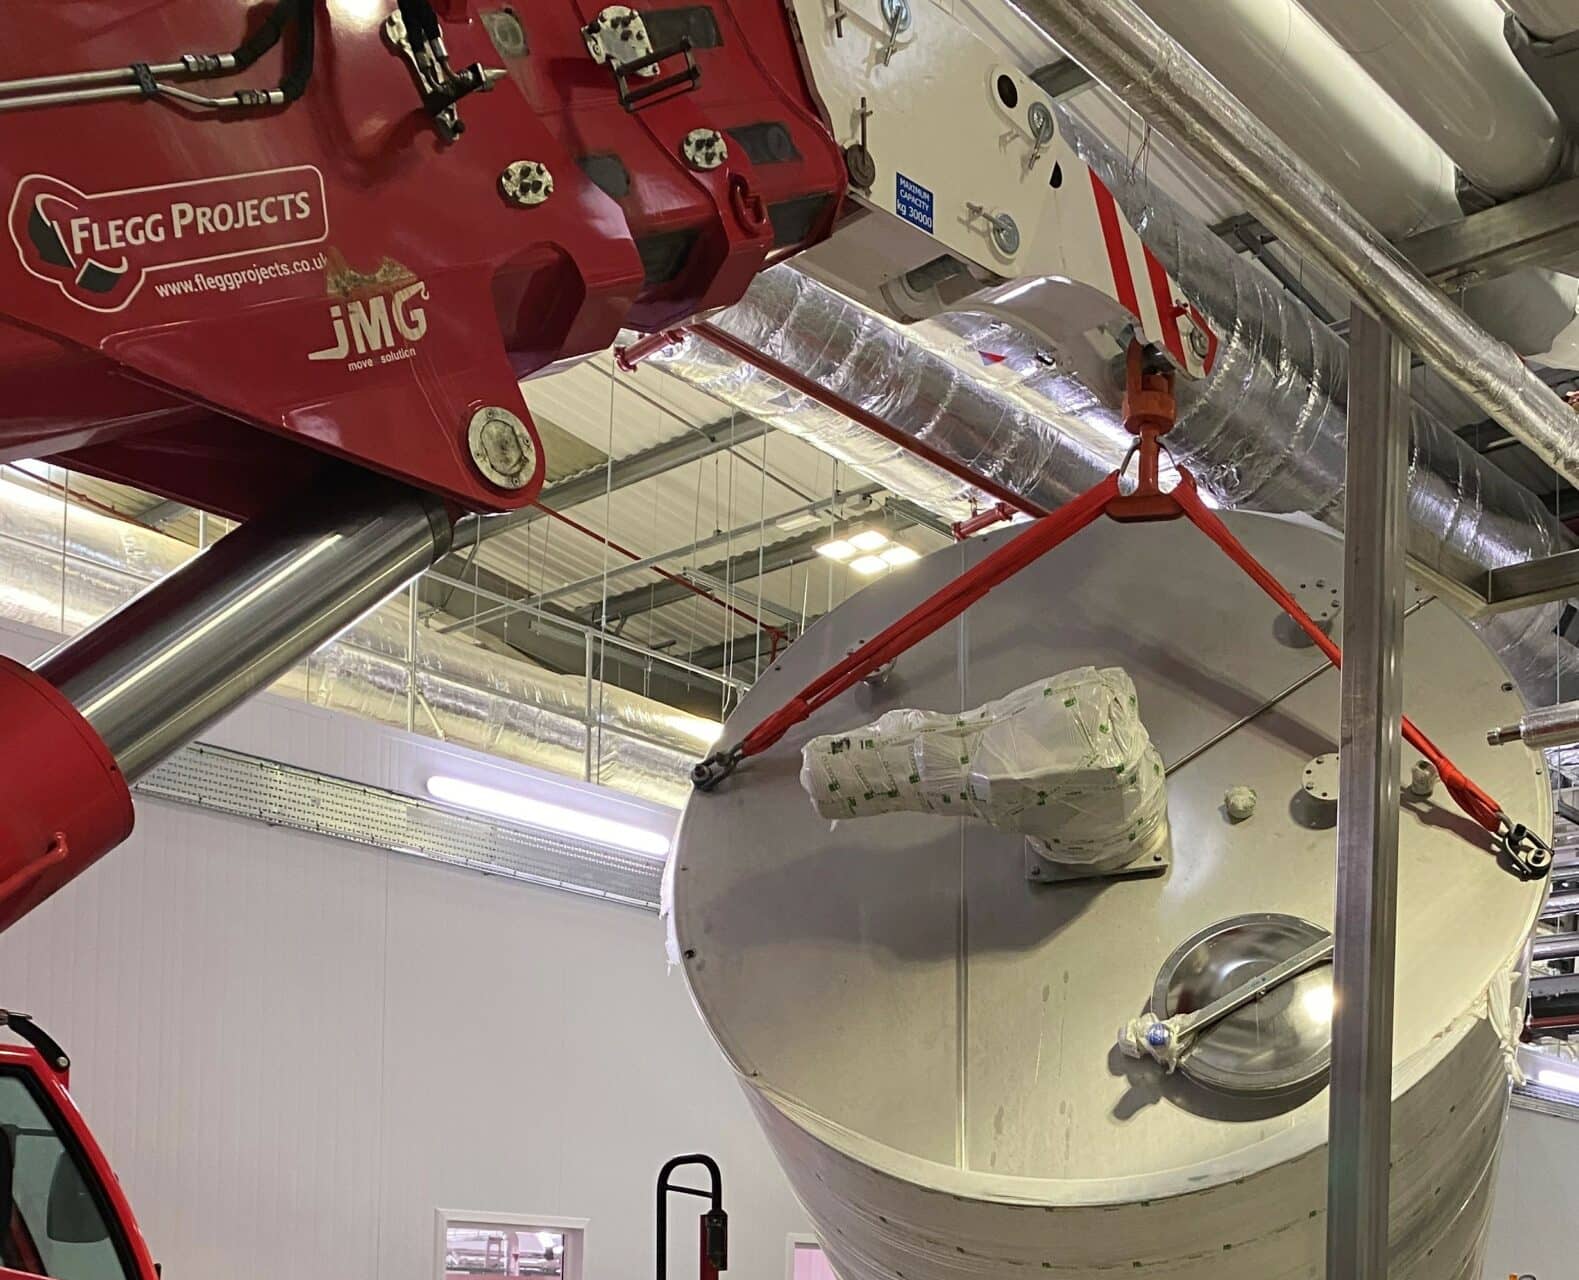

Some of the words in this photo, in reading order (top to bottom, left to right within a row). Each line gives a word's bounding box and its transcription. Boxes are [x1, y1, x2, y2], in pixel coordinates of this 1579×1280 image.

[899, 189, 929, 211] CAPACITY
[900, 178, 930, 202] MAXIMUM
[71, 212, 165, 254] FLEGG
[171, 191, 311, 239] PROJECTS
[897, 199, 907, 216] kg
[908, 206, 932, 229] 30000
[348, 358, 373, 372] move
[380, 347, 416, 364] solution
